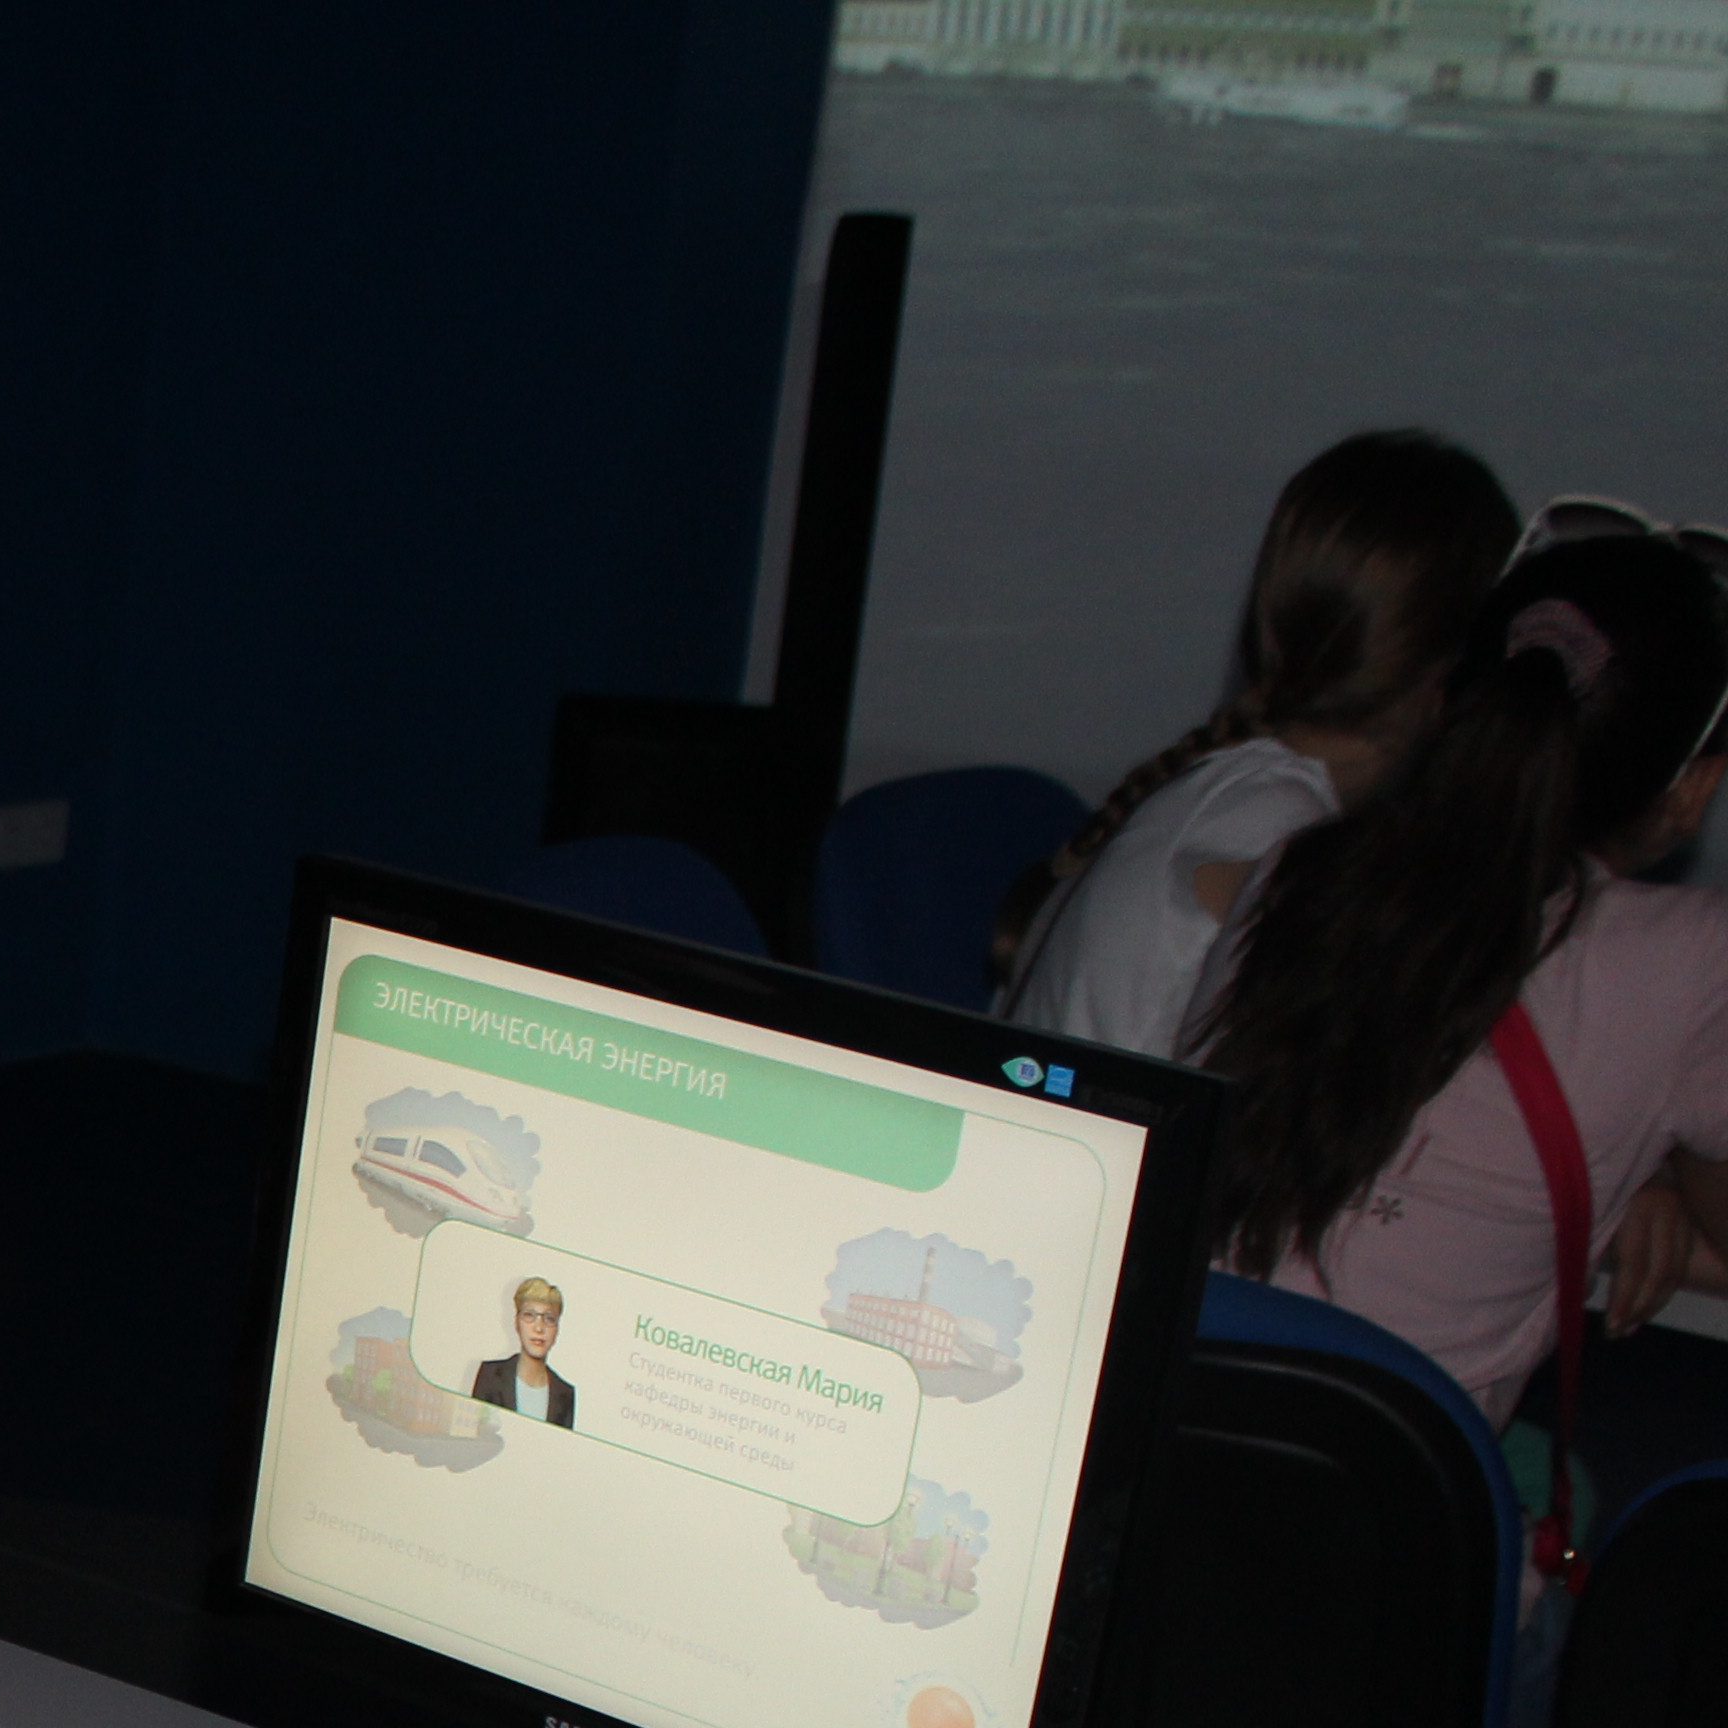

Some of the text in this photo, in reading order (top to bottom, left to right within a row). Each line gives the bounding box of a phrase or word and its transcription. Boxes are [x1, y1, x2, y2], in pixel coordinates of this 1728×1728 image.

[373, 981, 728, 1100] ЭЛЕКТРИЧЕСКАЯ ЭНЕРГИЯ
[628, 1351, 848, 1435] Студентка первого курса
[633, 1314, 885, 1414] Ковалевская Мария
[619, 1405, 795, 1472] окружающей среды
[623, 1378, 796, 1446] кафедры энергии и
